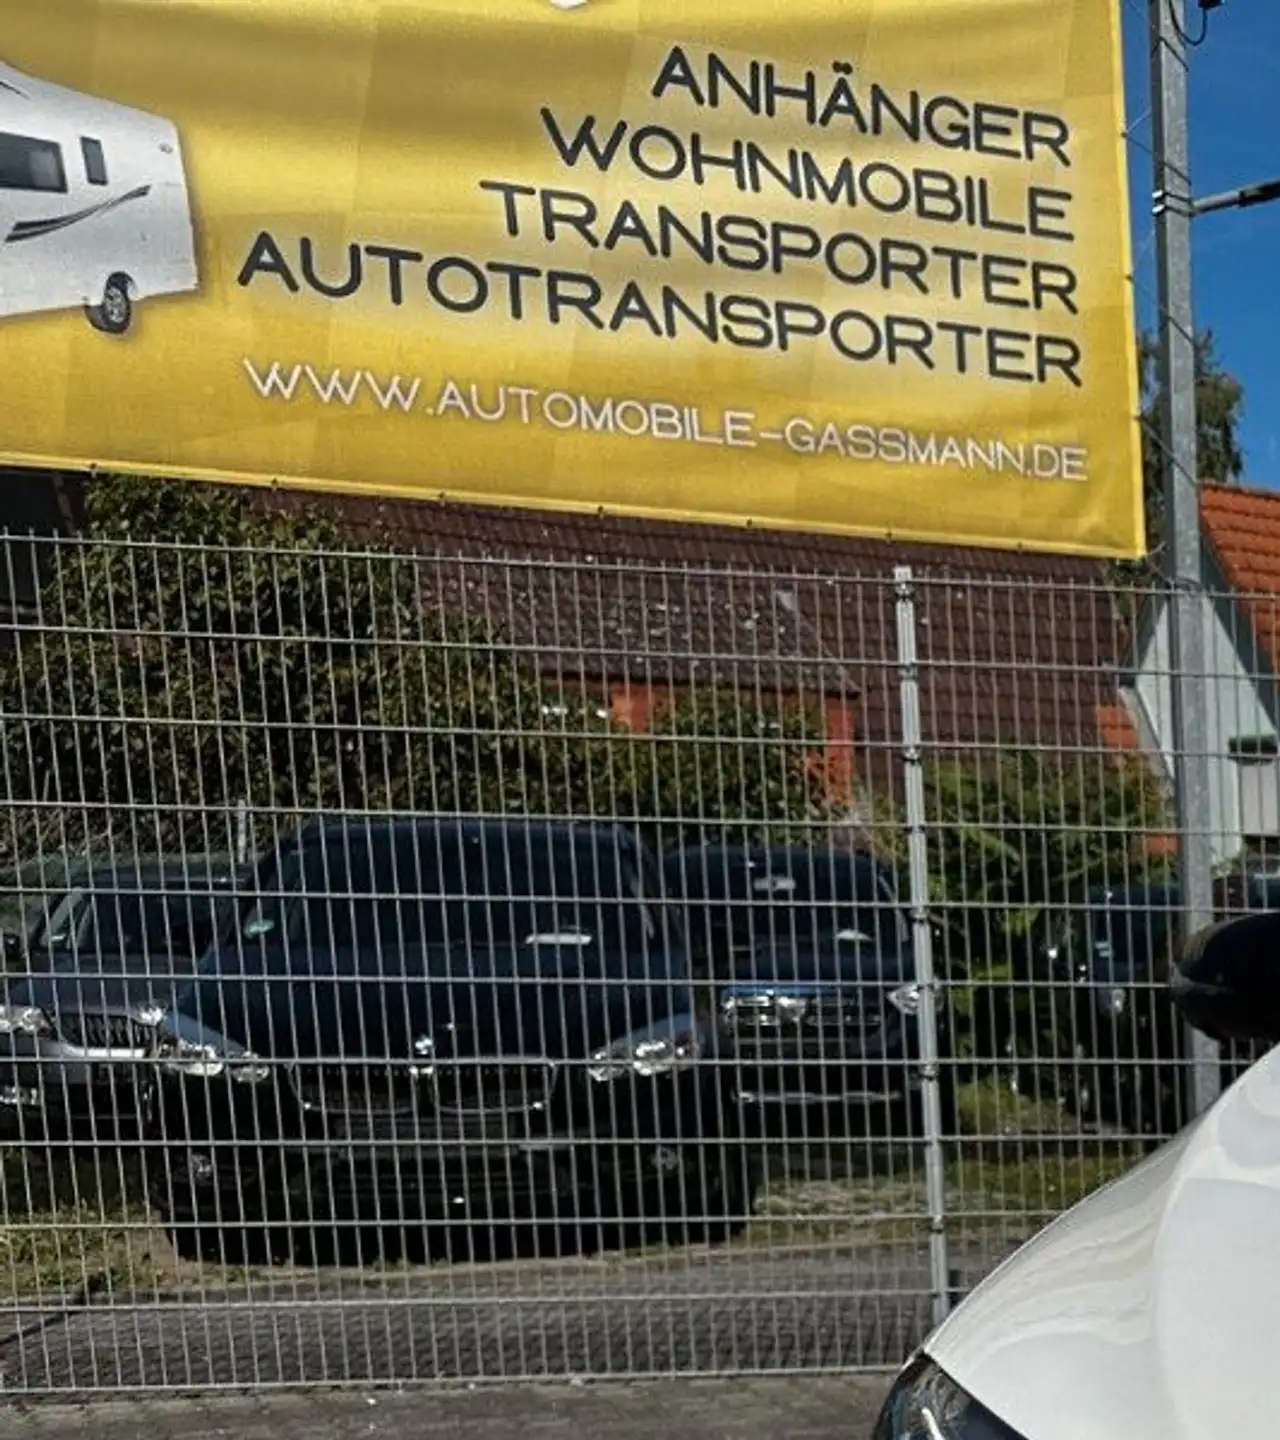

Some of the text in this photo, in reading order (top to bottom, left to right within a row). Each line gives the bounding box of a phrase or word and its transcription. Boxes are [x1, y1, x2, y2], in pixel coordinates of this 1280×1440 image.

[540, 106, 1075, 242] WOHNMOBILE
[652, 46, 1071, 167] ANHÄNGER
[237, 231, 1083, 387] AUTOTRANSPORTER
[480, 180, 1079, 315] TRANSPORTER
[242, 357, 1089, 481] WWW.AUTOMOBILE-GASSMANN.DE
